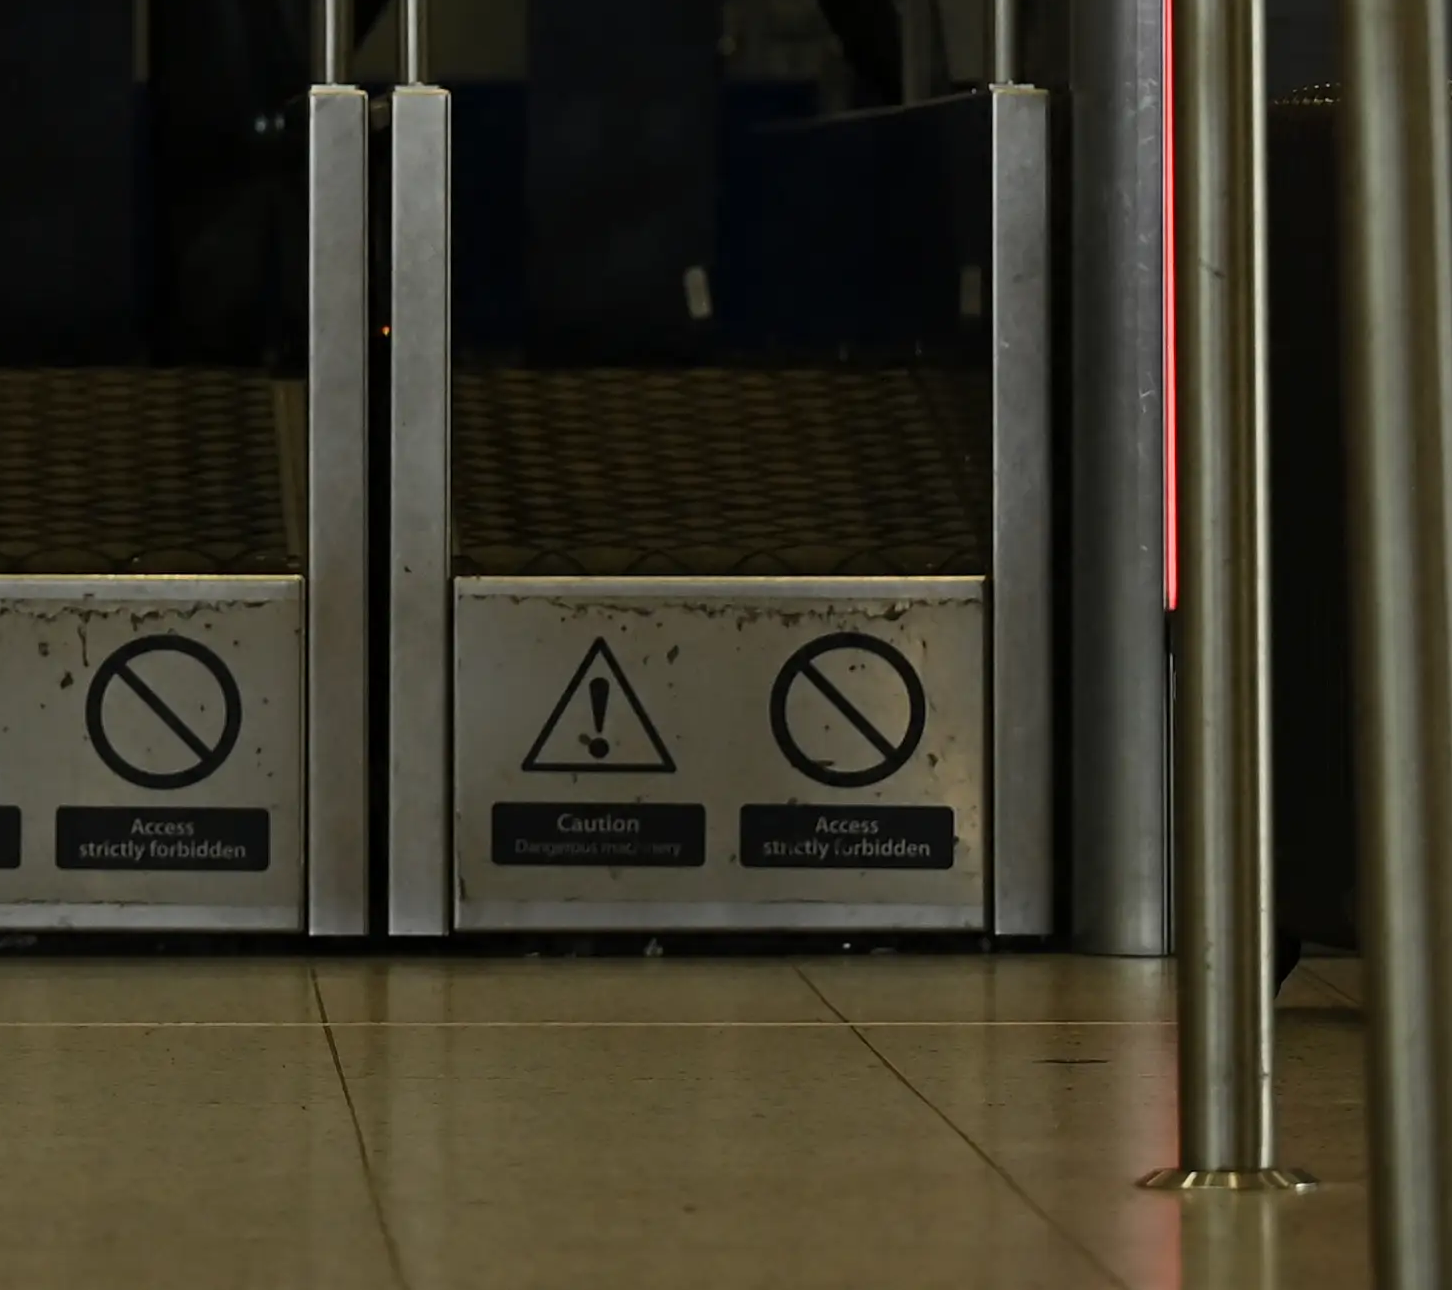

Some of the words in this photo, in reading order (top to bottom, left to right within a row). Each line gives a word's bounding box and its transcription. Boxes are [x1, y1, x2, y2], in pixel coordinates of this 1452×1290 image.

[129, 817, 194, 836] Access
[557, 815, 639, 834] Caution
[816, 816, 879, 834] Access
[79, 839, 145, 861] strictly
[149, 839, 246, 859] forbidden
[763, 839, 827, 860] strictly
